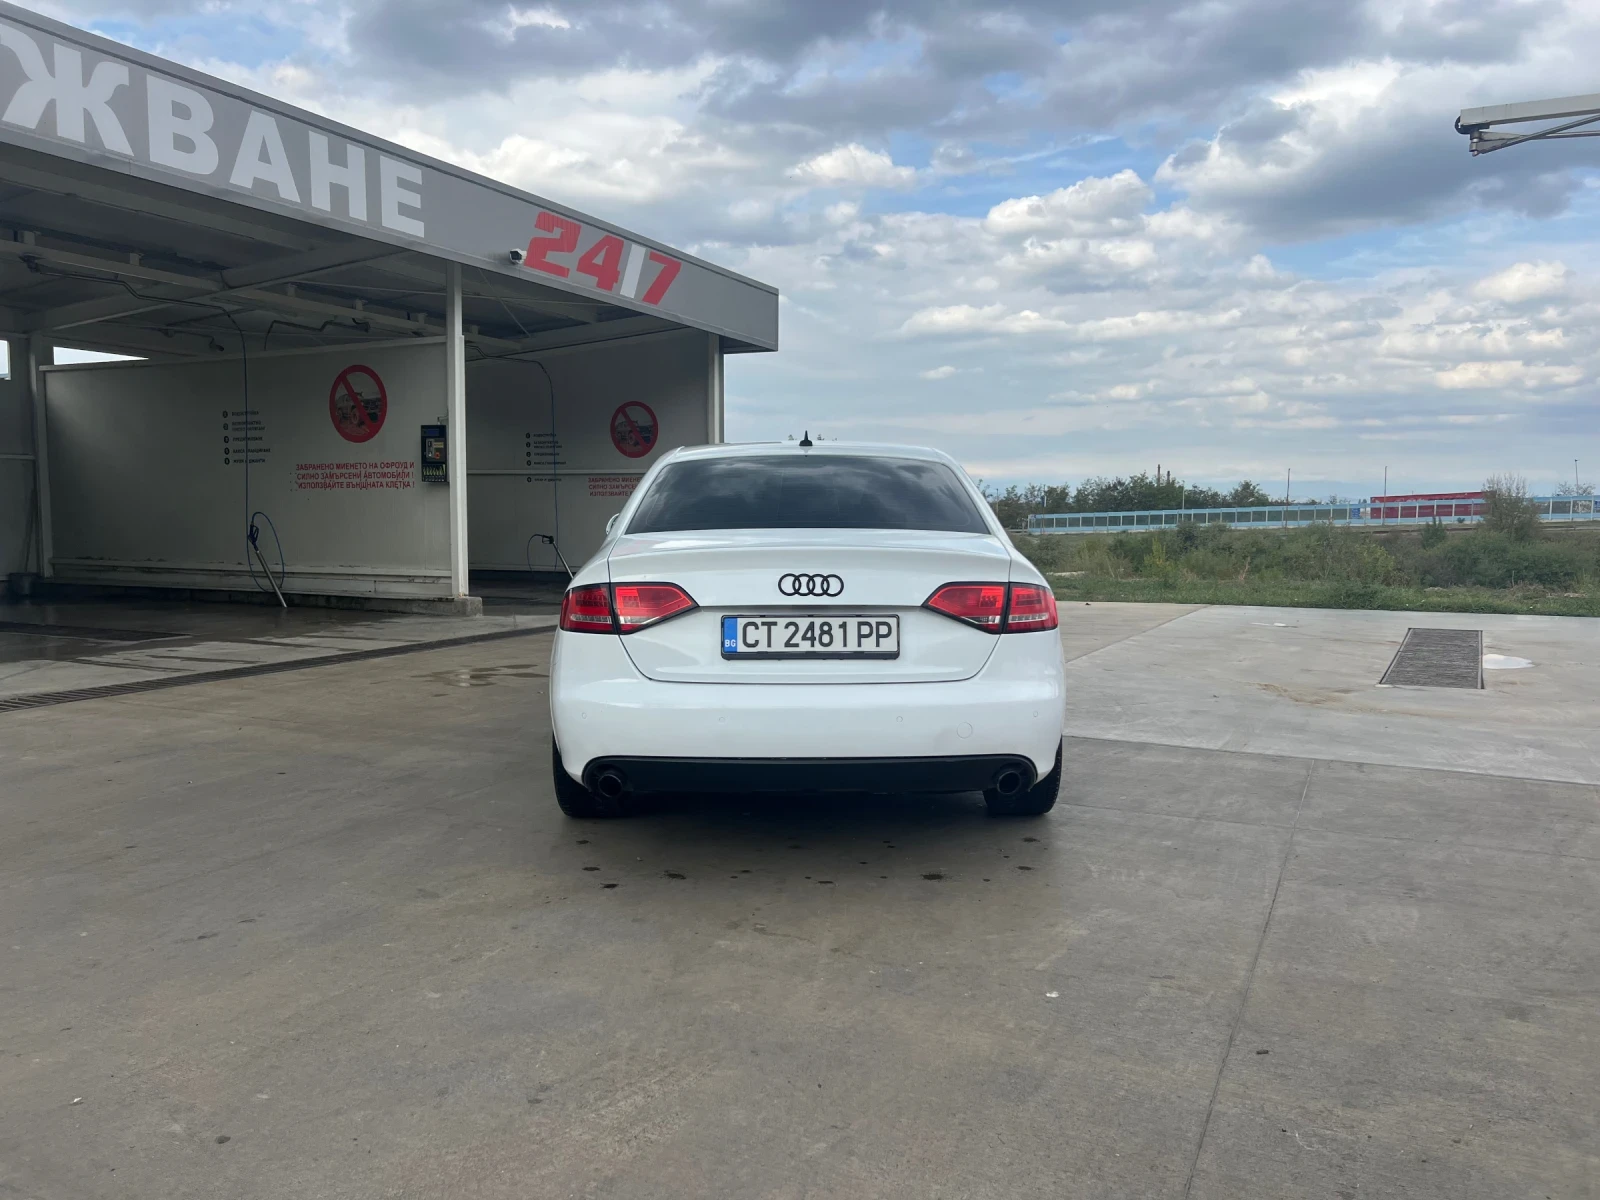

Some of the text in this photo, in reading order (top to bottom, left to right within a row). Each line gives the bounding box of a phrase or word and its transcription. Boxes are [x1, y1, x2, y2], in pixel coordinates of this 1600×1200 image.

[295, 463, 335, 471] ЗАБРАНЕНО
[335, 462, 368, 470] МИЕНЕТО
[379, 462, 408, 470] ОФРОУД
[409, 461, 415, 469] И
[296, 472, 320, 480] СИЛНО
[320, 472, 362, 480] ЗАМЪРСЕНИ
[363, 471, 410, 479] АВТОМОБИЛИ
[297, 481, 345, 489] ИЗПОЛЗВАЙТЕ
[385, 481, 411, 489] КЛЕТКА
[724, 621, 893, 648] BG CT 2481 PP
